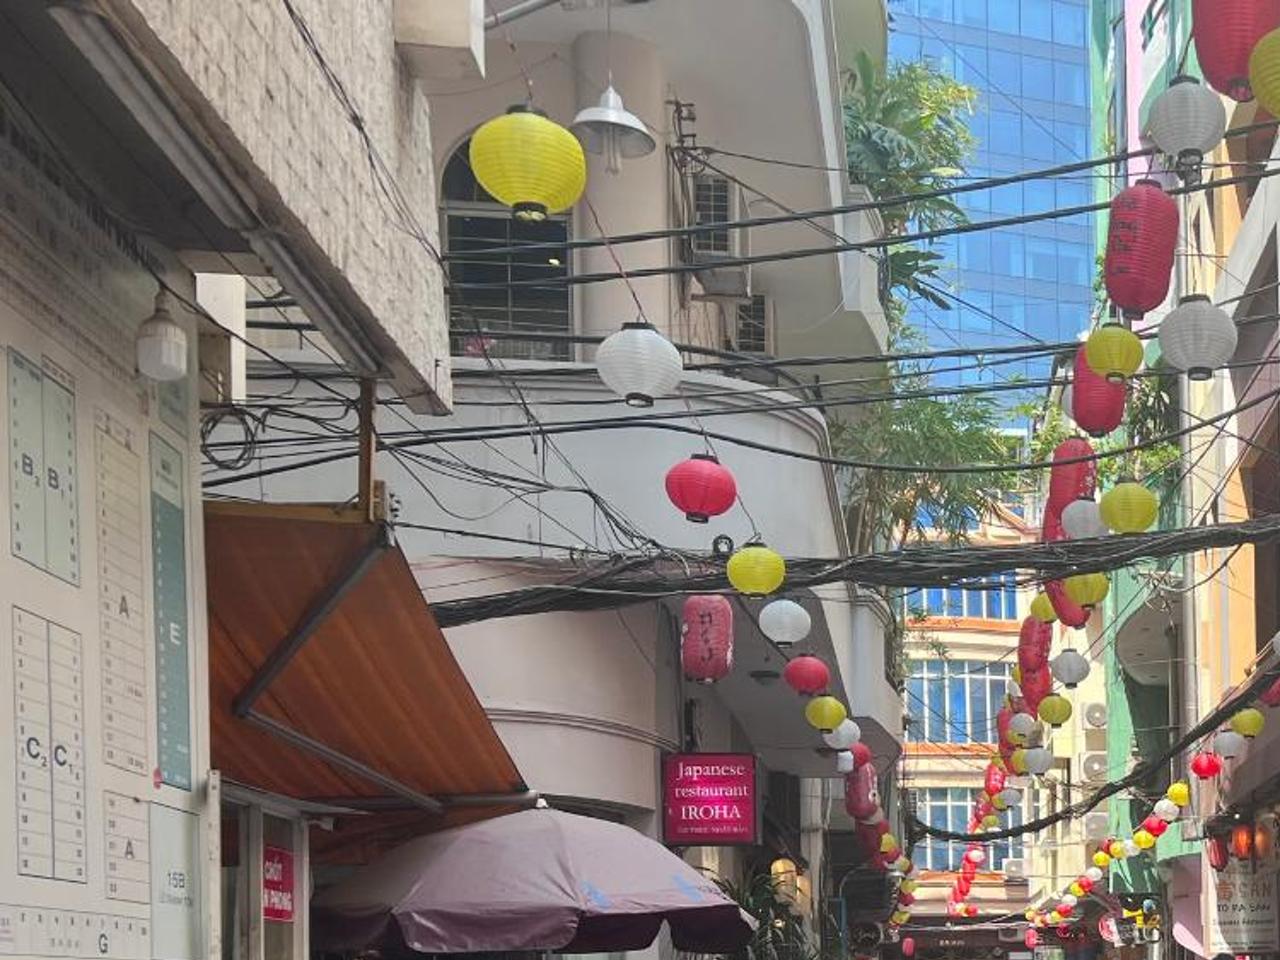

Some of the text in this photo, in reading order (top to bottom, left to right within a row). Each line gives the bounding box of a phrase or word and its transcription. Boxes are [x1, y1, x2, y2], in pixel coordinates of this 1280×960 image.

[676, 762, 746, 781] Japanese
[675, 786, 749, 798] restaurant
[681, 804, 742, 820] IROHA
